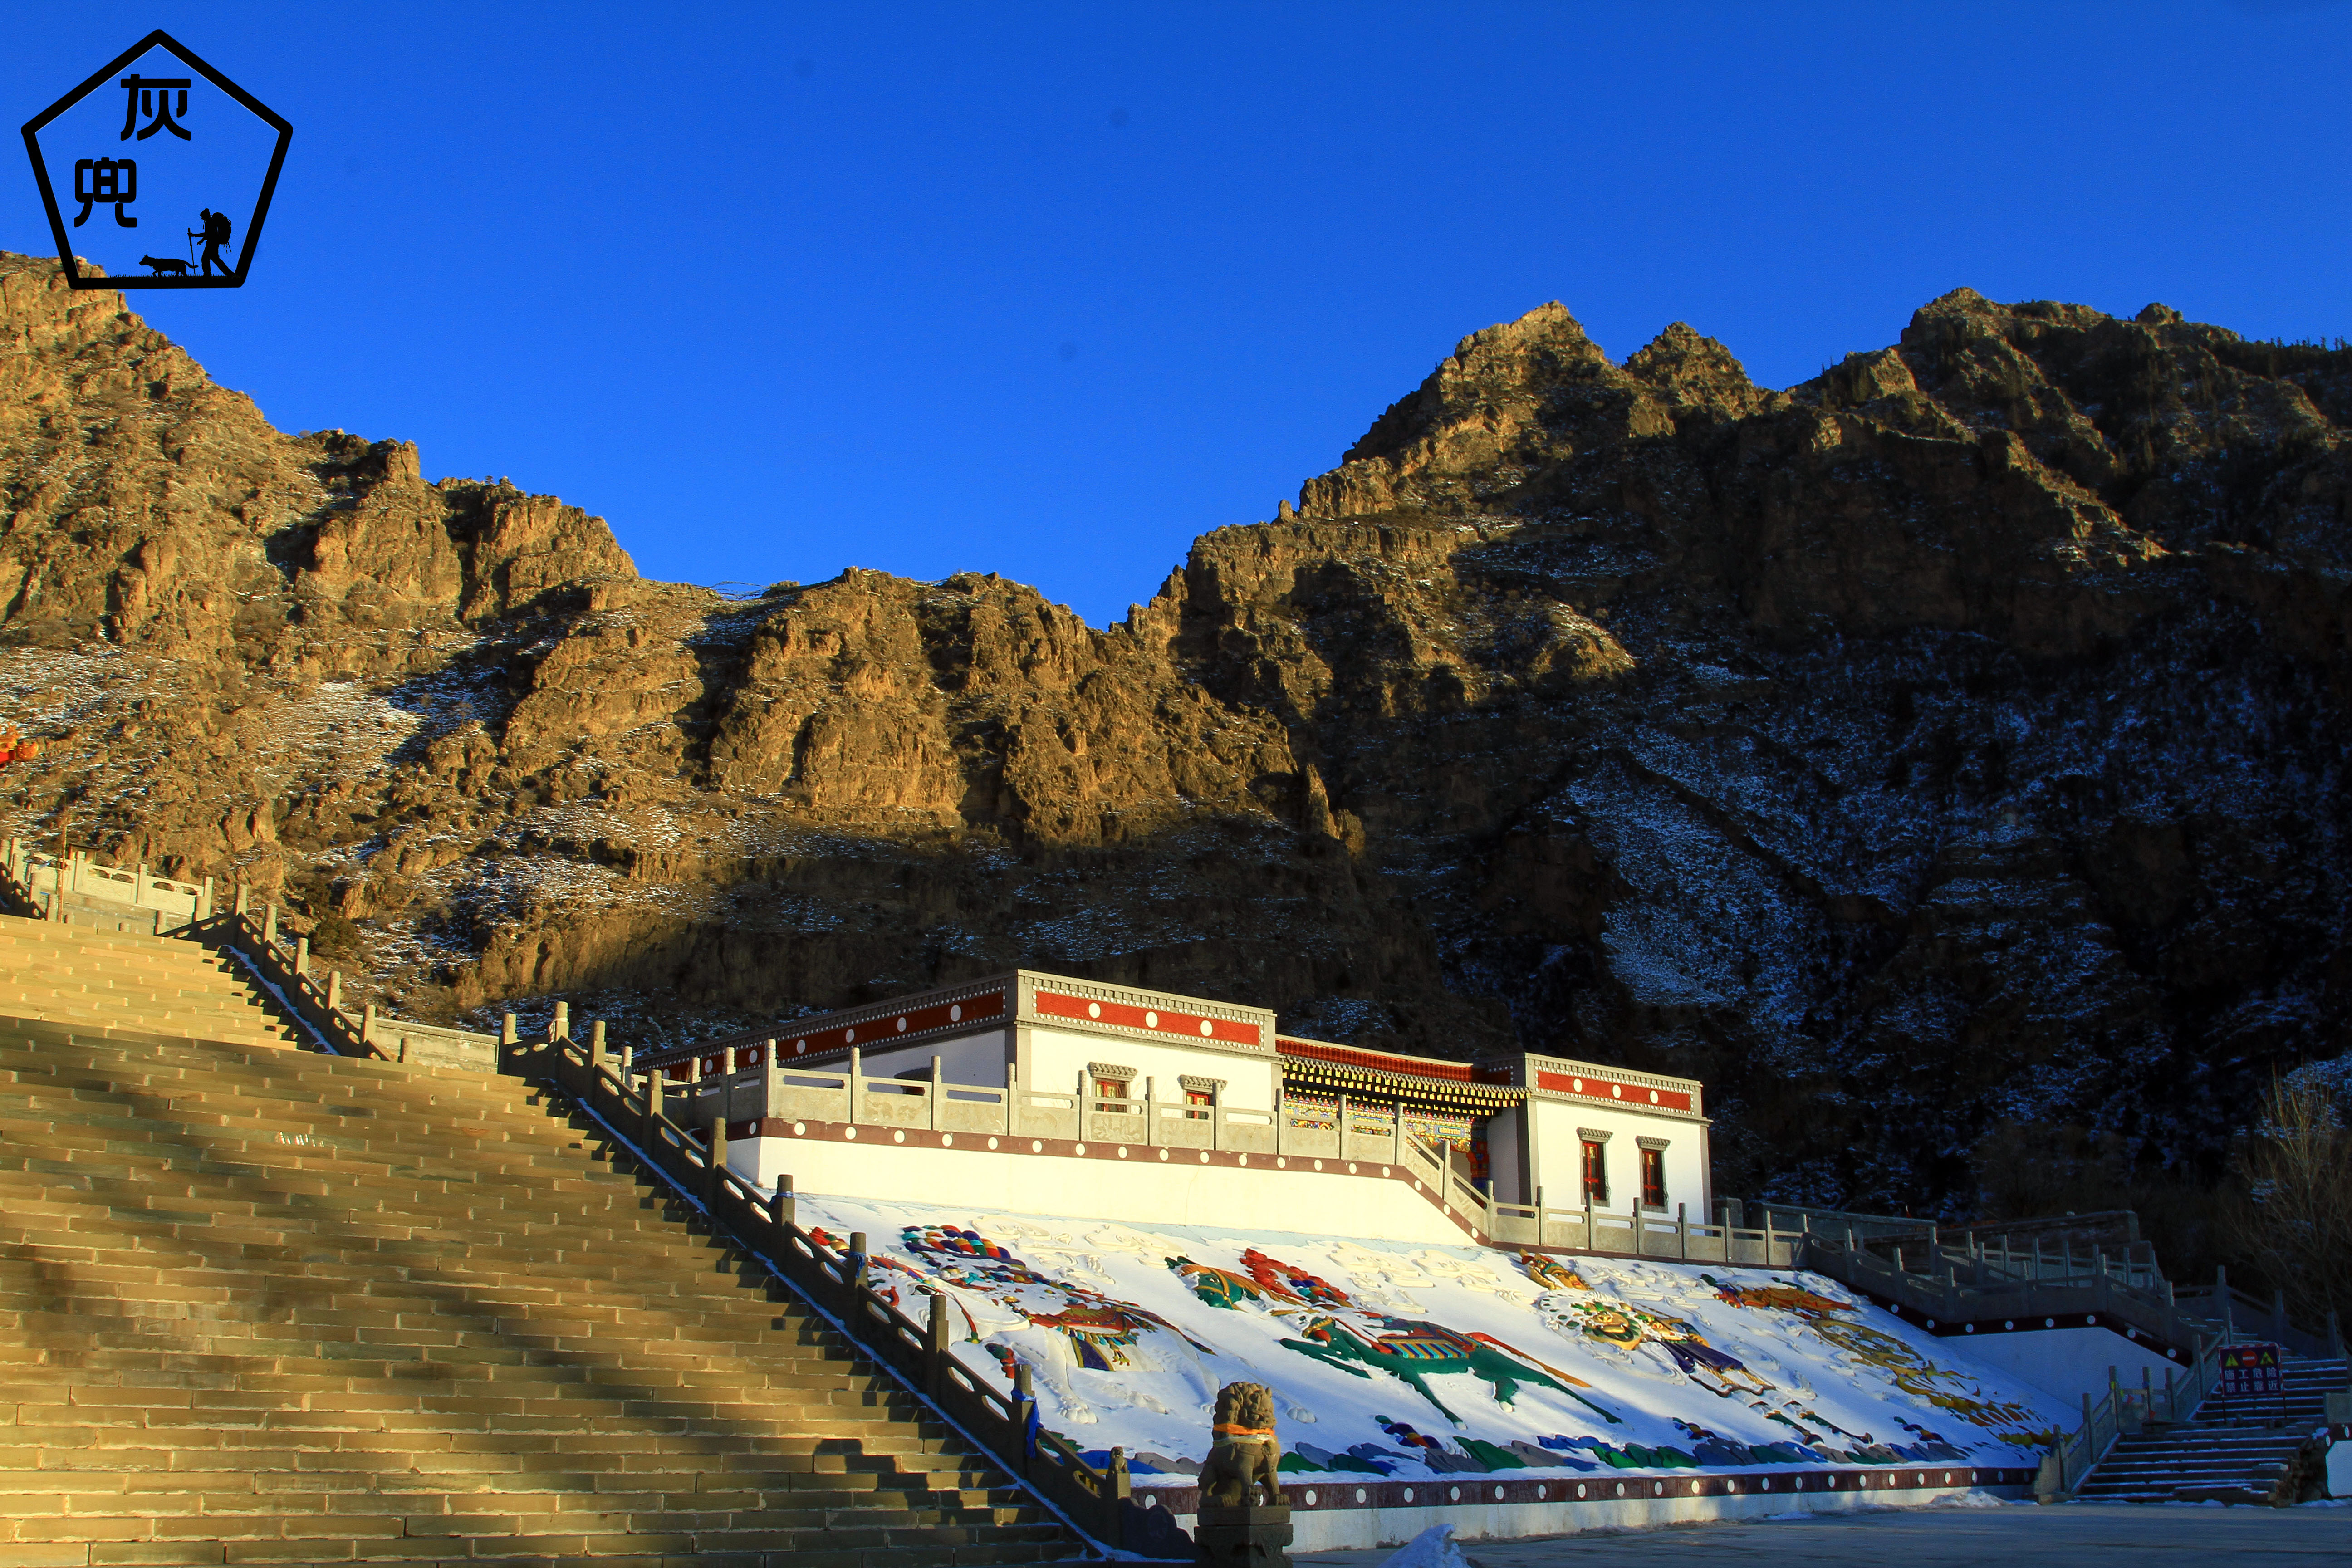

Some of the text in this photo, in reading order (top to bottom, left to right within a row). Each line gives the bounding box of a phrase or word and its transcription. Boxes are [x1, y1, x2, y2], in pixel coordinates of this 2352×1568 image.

[2224, 1367, 2277, 1380] 施工危险
[2225, 1380, 2278, 1393] 禁止靠近
